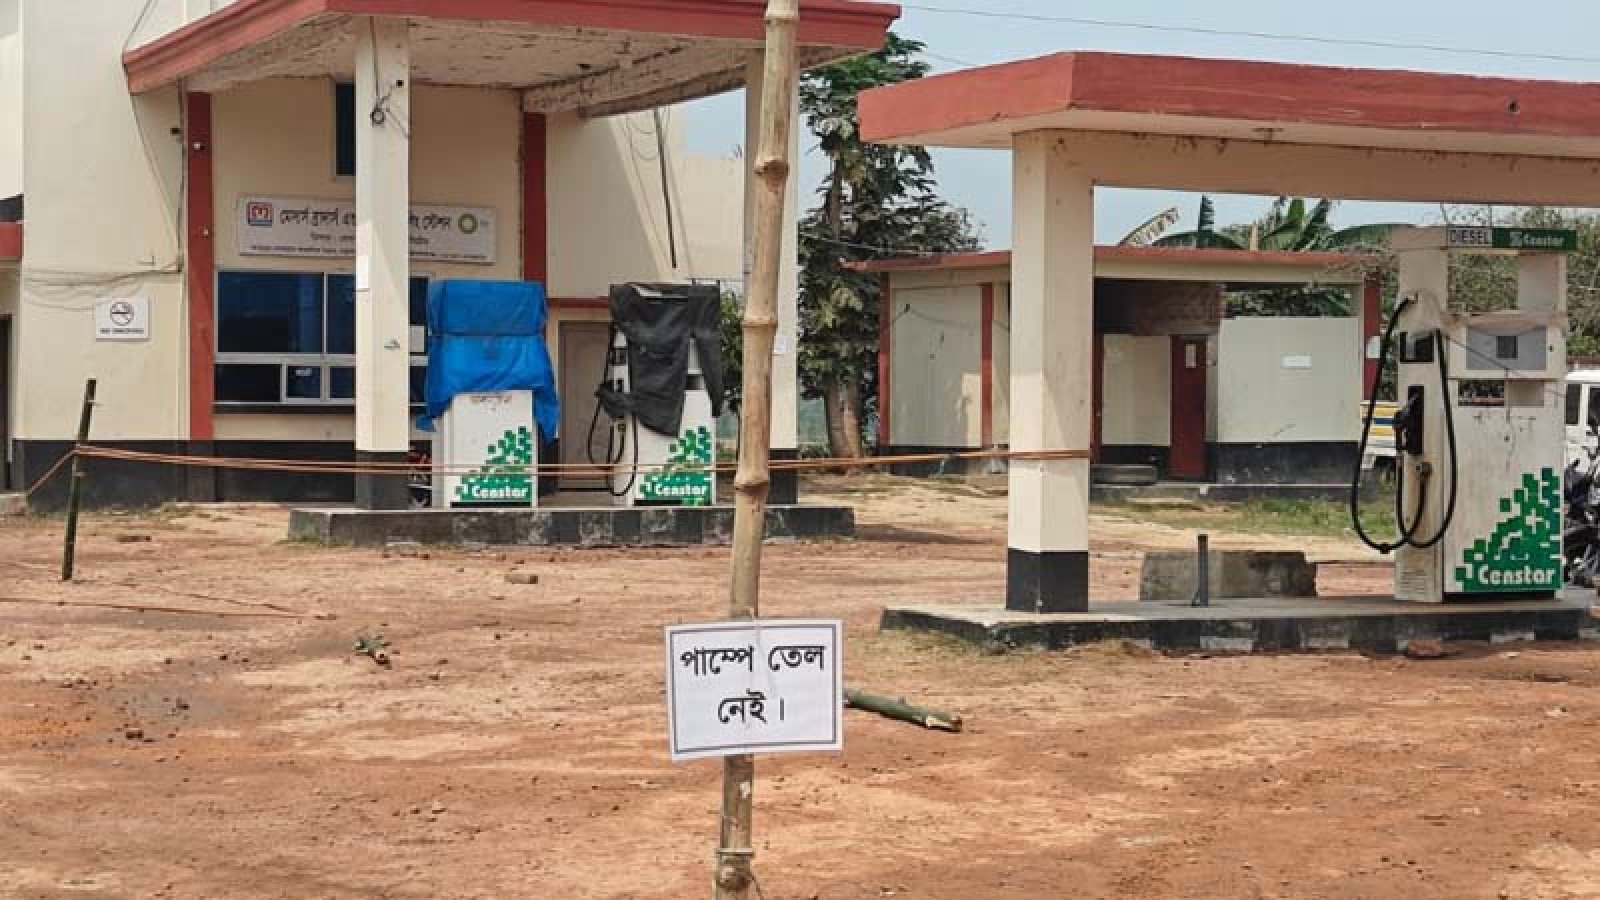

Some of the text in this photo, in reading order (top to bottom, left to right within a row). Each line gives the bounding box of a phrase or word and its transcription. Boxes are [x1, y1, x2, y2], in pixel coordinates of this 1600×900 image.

[1449, 229, 1489, 244] DIESEL
[1523, 233, 1565, 247] Censtar
[471, 485, 529, 498] Censtar
[654, 483, 708, 496] Censtar
[1478, 564, 1556, 585] Censtar
[680, 645, 826, 676] পাম্পে তেল
[718, 688, 767, 724] নেই
